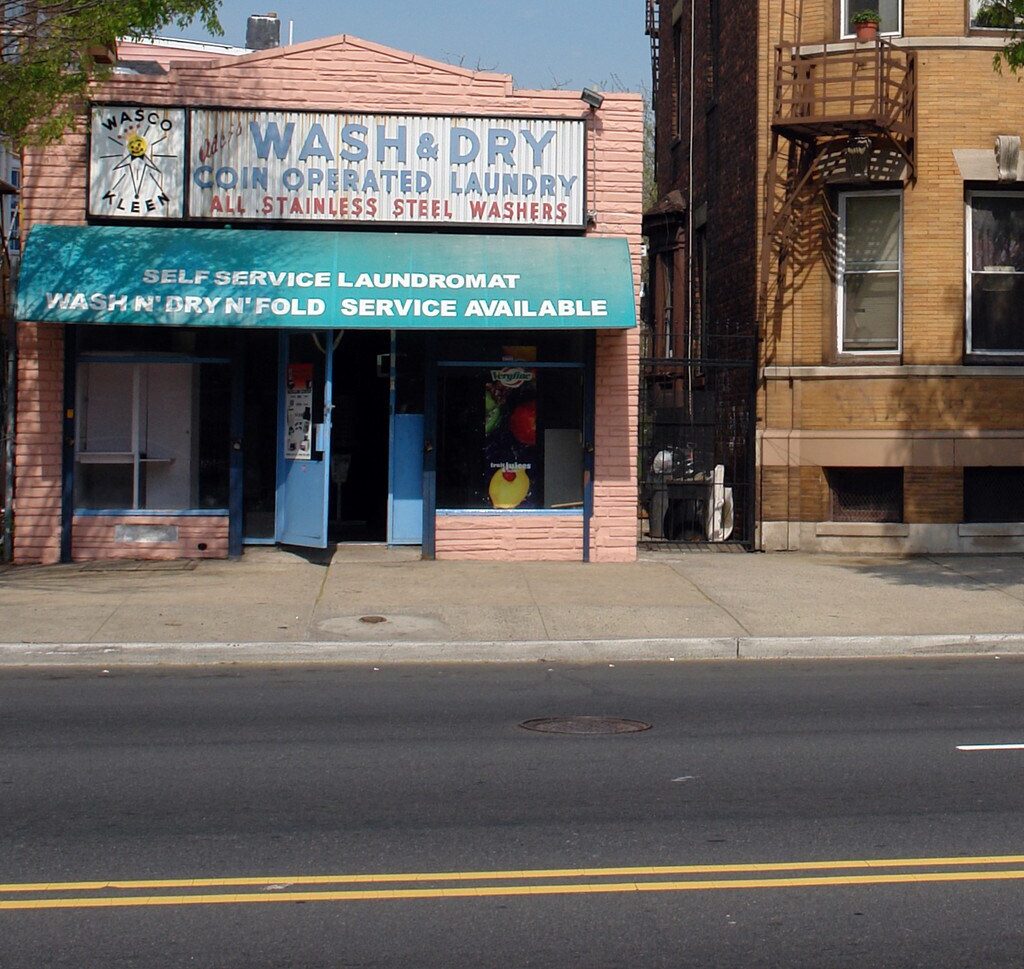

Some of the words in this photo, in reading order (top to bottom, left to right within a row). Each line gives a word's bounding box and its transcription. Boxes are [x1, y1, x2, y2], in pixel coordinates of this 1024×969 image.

[102, 109, 172, 132] WASCO
[250, 121, 407, 164] WASH
[416, 132, 439, 160] &
[449, 126, 557, 167] DRY
[193, 165, 268, 191] COIN
[282, 167, 432, 195] OPERATED
[451, 170, 578, 197] LAUNDRY
[102, 190, 170, 213] KLEEN
[210, 195, 246, 214] ALL
[261, 196, 377, 216] STAINLESS
[392, 198, 452, 218] STEEL
[469, 200, 567, 221] WASHERS
[142, 269, 210, 284] SELF
[214, 270, 331, 288] SERVICE
[338, 272, 520, 289] LAUNDROMAT
[45, 292, 128, 312] WASH
[165, 295, 221, 313] DRY
[255, 298, 326, 316] FOLD
[340, 299, 457, 317] SERVICE
[464, 299, 608, 317] AVAILABLE
